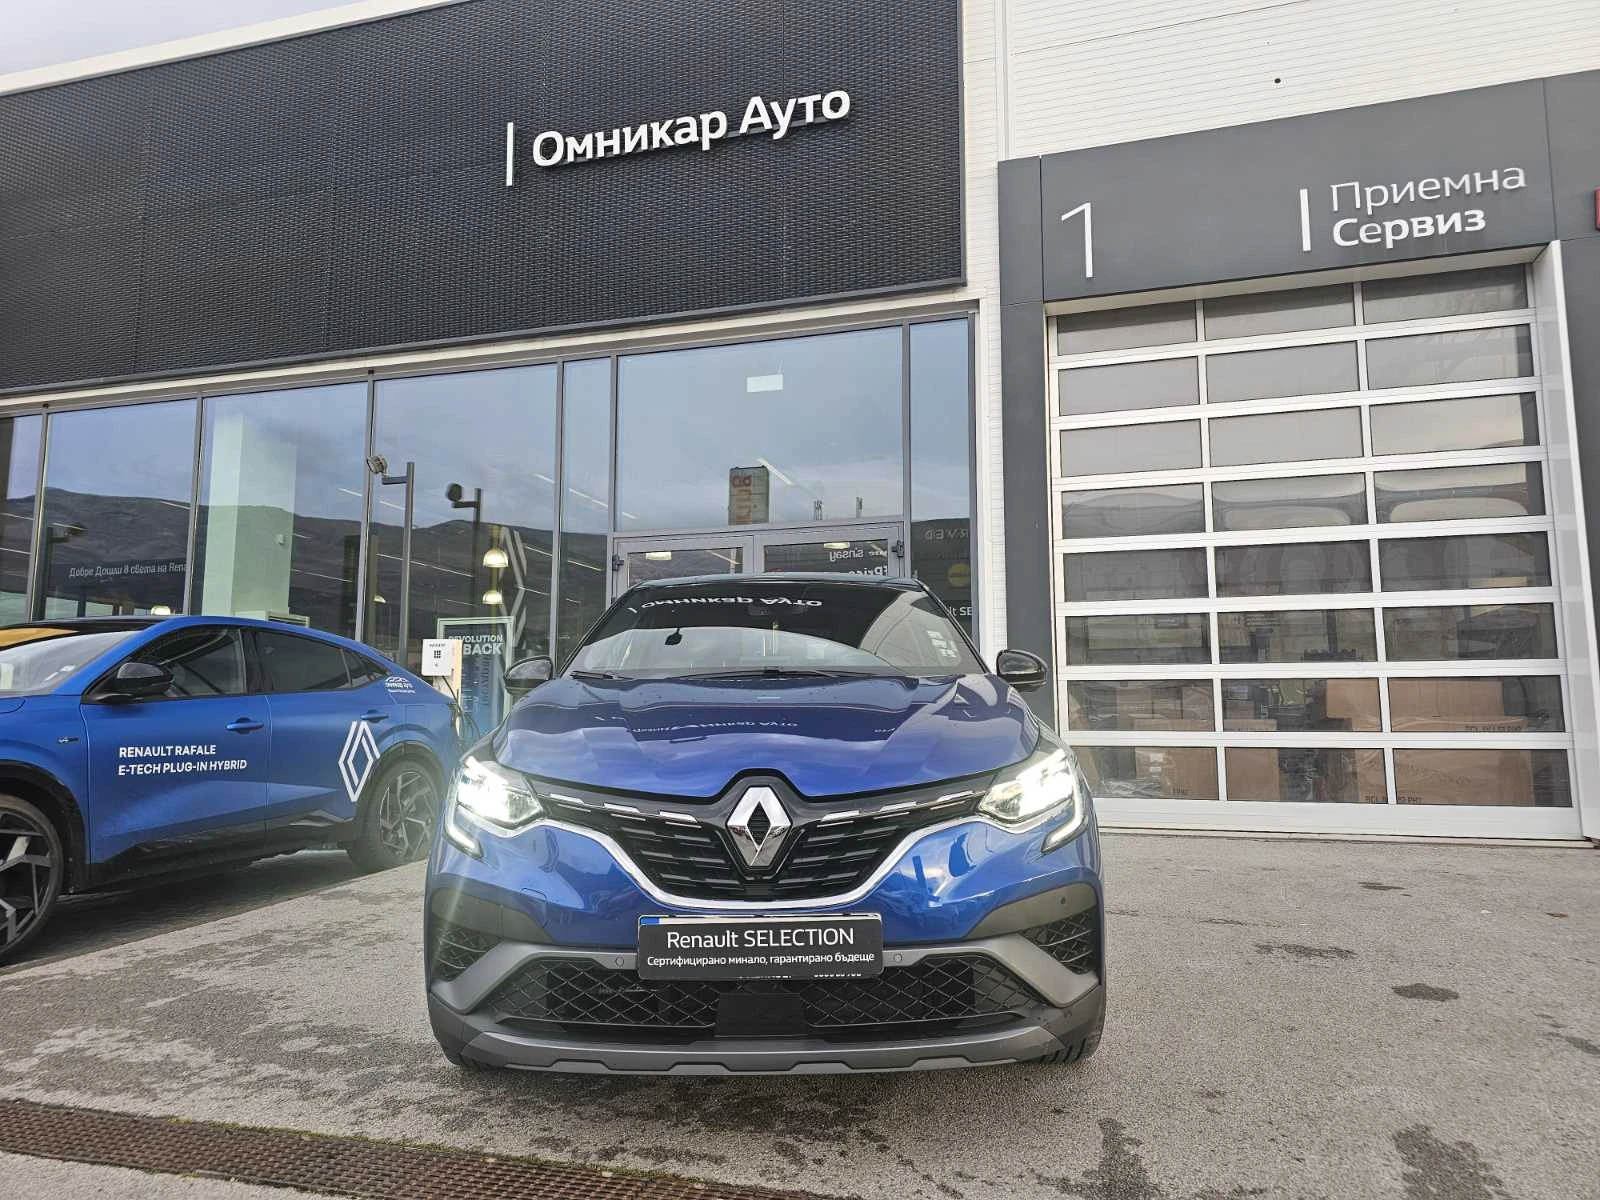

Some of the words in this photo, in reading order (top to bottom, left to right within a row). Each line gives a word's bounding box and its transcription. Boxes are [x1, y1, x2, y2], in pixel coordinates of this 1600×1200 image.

[532, 108, 728, 167] Омникар
[739, 89, 851, 141] Ауто
[1330, 166, 1527, 215] Приемна
[1332, 207, 1487, 249] Сервиз
[1061, 201, 1094, 279] 1
[95, 565, 122, 576] Дошли
[463, 642, 504, 655] BACK
[119, 746, 173, 758] RENAULT
[175, 745, 217, 756] RAFALE
[118, 763, 161, 776] E-TECH
[162, 761, 208, 773] PLUG-IN
[209, 759, 247, 771] HYBRID
[666, 930, 739, 949] Renault
[743, 927, 855, 947] SELECTION
[647, 956, 727, 969] Сертифицирано
[728, 955, 768, 966] минало,
[769, 953, 833, 966] гарантирано
[834, 952, 875, 964] бъдеще
